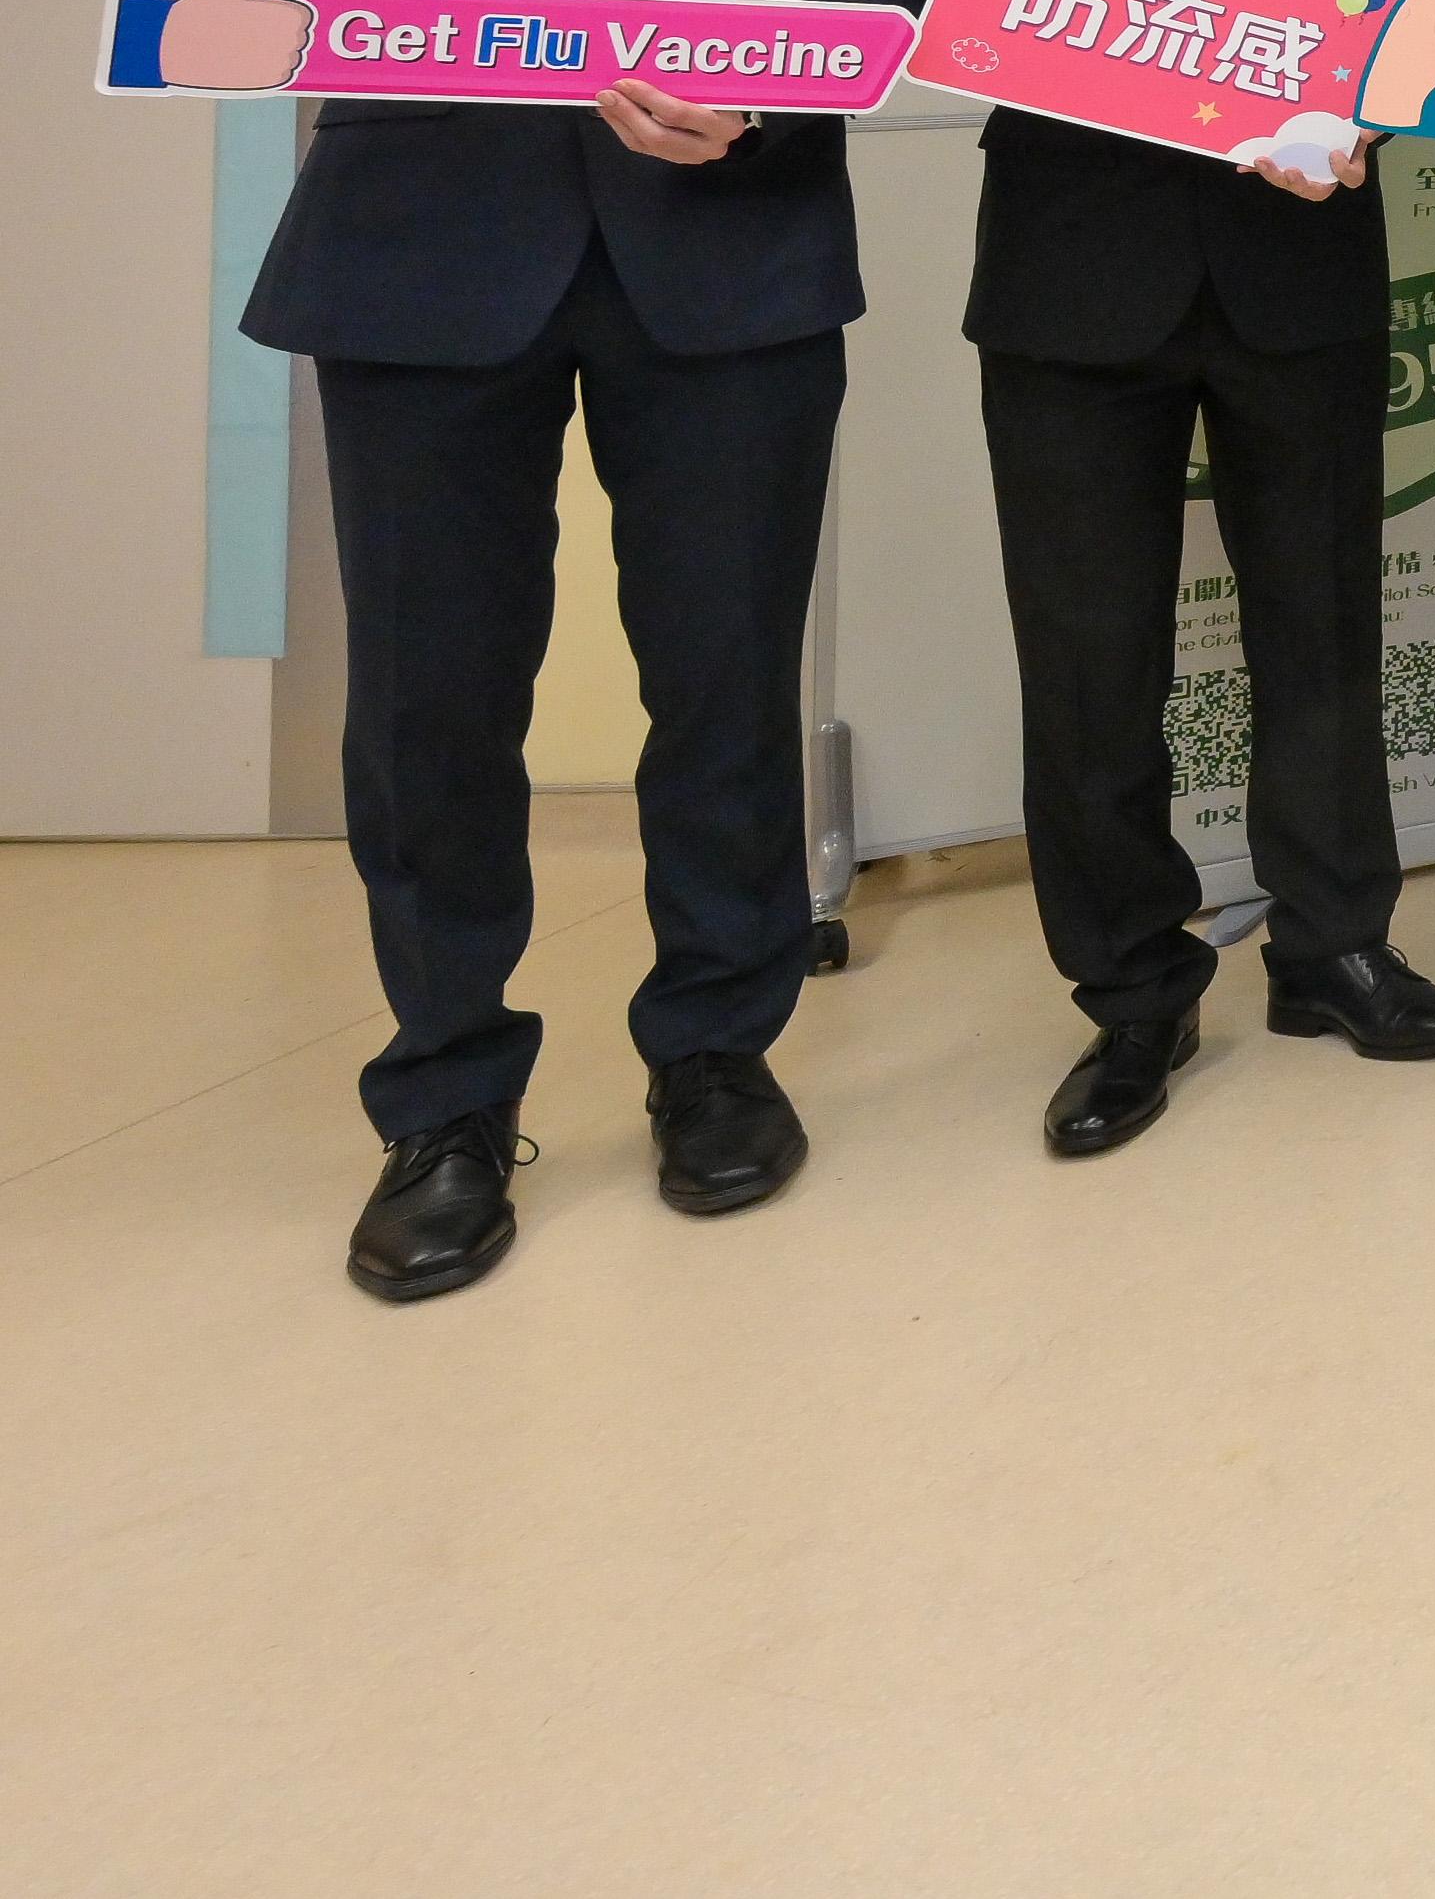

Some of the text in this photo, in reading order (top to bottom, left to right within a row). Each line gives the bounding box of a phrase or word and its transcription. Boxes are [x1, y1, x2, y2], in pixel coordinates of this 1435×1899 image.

[328, 9, 865, 80] Get Flu Vaccine
[1382, 585, 1412, 603] ilot
